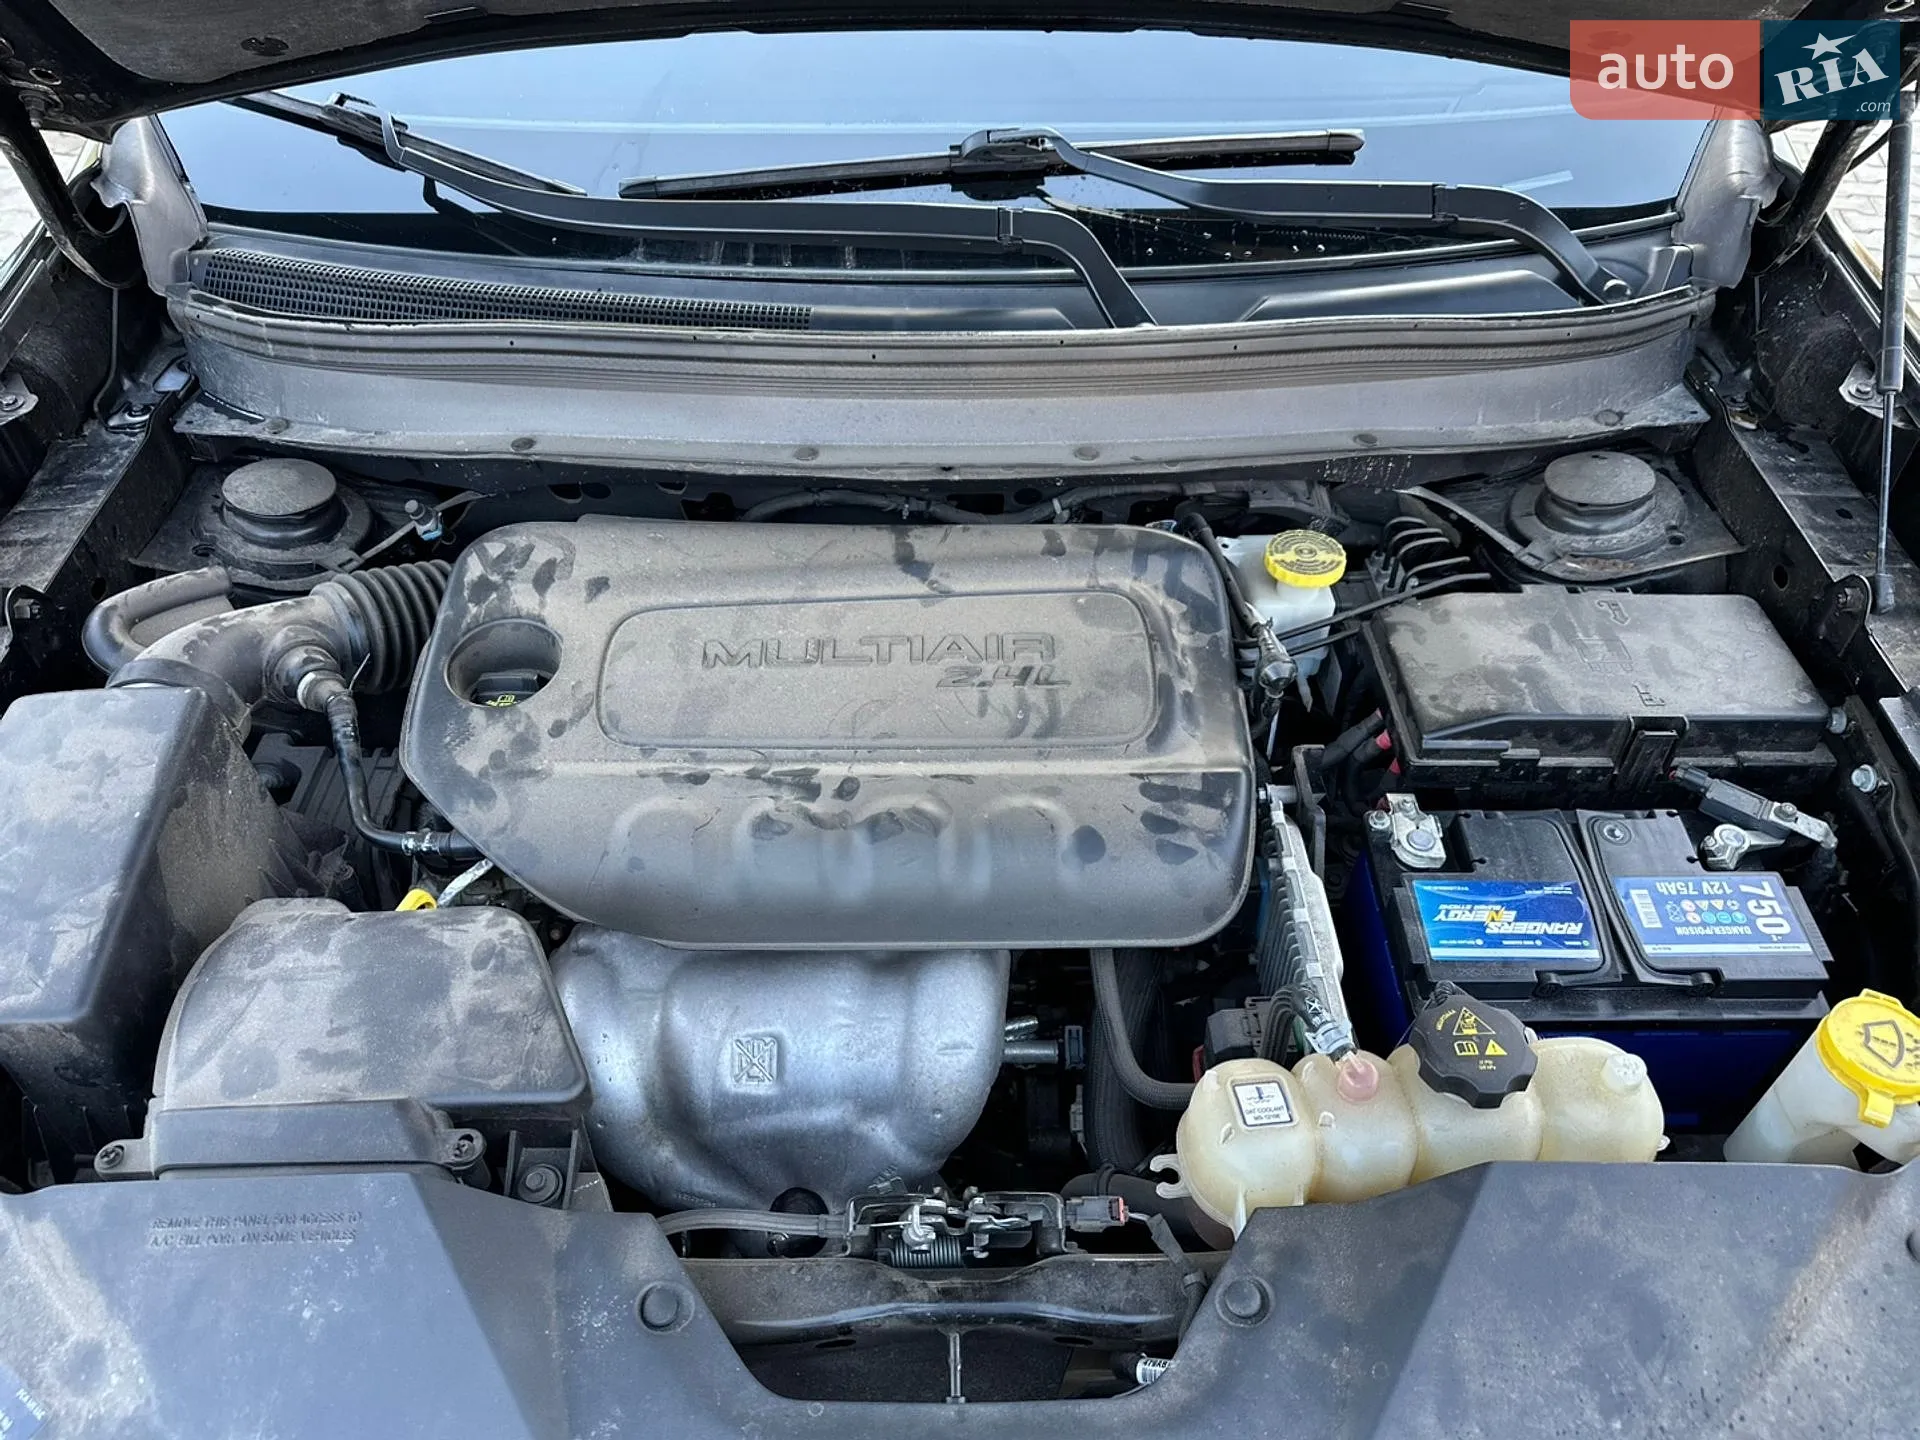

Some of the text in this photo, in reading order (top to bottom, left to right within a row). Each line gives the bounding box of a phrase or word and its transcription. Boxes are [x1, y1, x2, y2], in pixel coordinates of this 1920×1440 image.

[701, 632, 1057, 669] MULTIAIR
[1656, 881, 1733, 896] 12V 75Ah
[1739, 881, 1792, 936] 750
[1433, 910, 1518, 923] ENERGY
[1484, 921, 1584, 935] RANGERS
